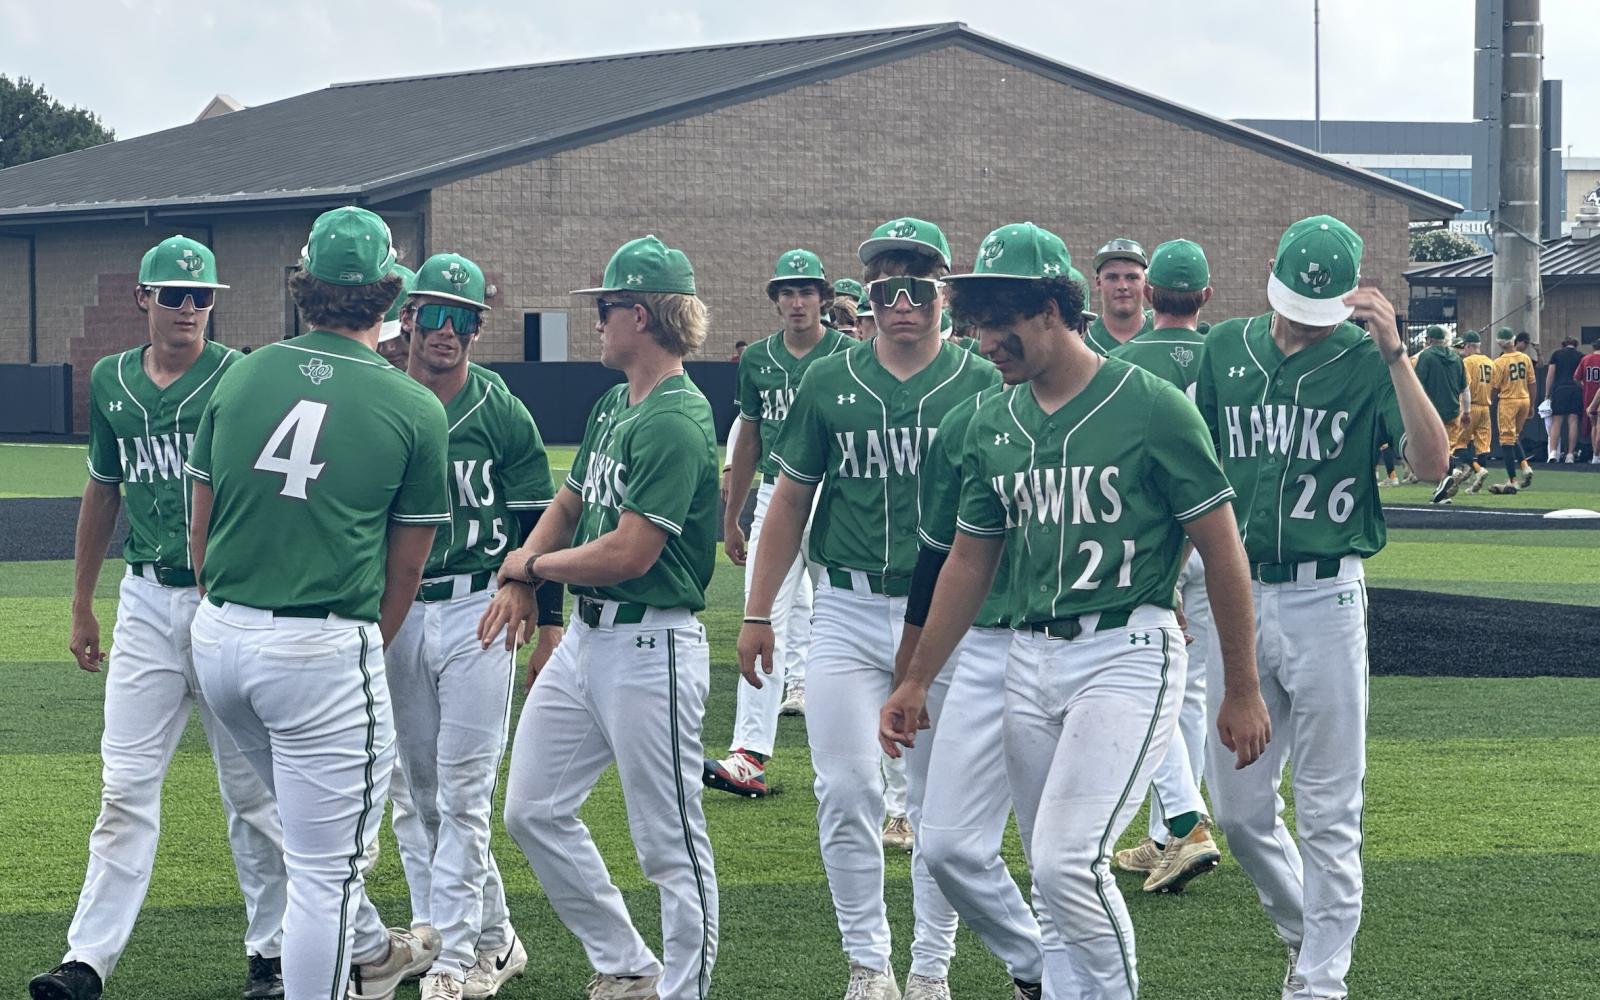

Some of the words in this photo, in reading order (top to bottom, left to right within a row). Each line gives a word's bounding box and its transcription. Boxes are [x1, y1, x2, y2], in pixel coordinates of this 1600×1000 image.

[1508, 361, 1526, 381] 26
[1585, 366, 1600, 381] 10
[253, 399, 328, 500] 4
[1224, 404, 1349, 461] HAWKS
[991, 465, 1123, 529] HAWKS
[1289, 473, 1357, 523] 26
[465, 517, 508, 556] 15
[1071, 539, 1136, 590] 21
